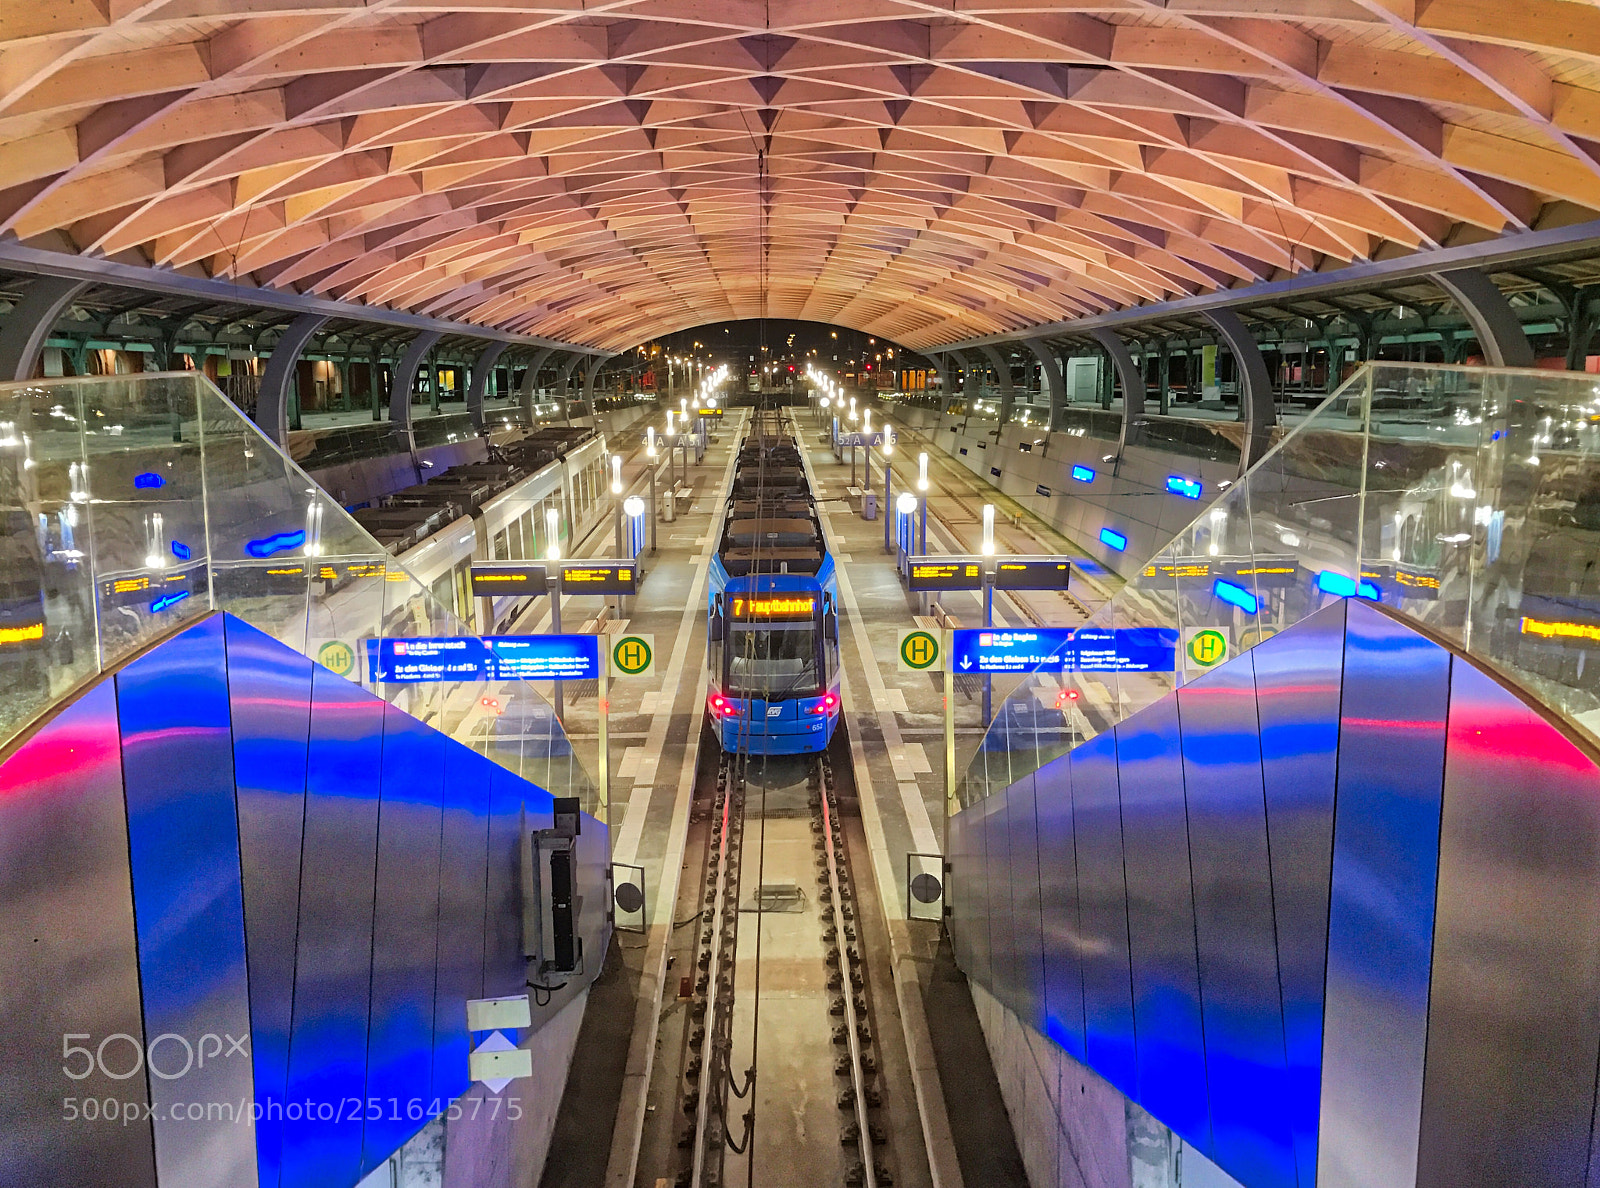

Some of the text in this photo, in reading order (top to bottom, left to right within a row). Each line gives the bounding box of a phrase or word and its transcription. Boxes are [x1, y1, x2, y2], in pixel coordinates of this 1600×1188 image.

[641, 436, 648, 446] 4
[656, 436, 665, 446] A
[677, 436, 685, 446] A
[853, 435, 861, 445] A
[873, 434, 882, 445] A
[890, 434, 897, 445] 6
[734, 598, 814, 616] 7 Hauptbahnhof
[624, 644, 641, 666] H
[911, 640, 927, 660] H
[1200, 638, 1215, 659] H
[989, 655, 1002, 663] den
[811, 723, 823, 732] 652
